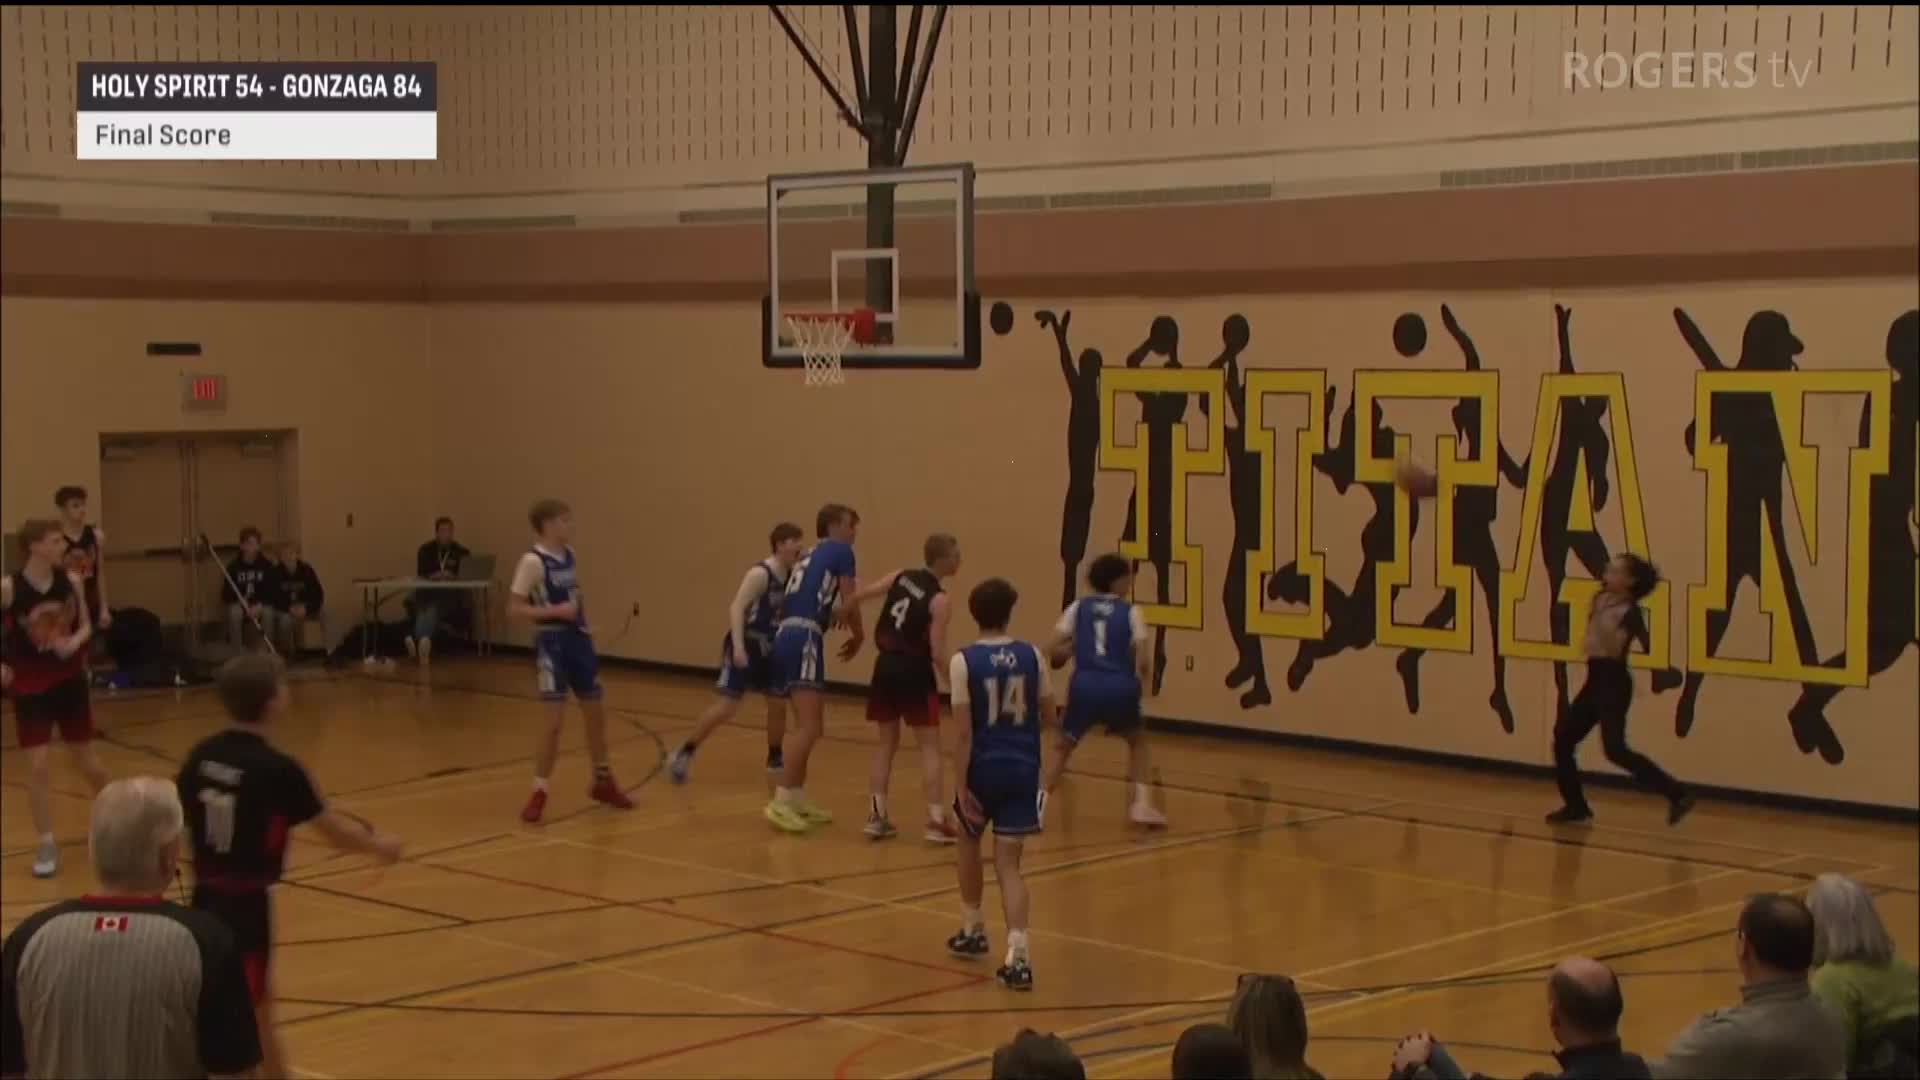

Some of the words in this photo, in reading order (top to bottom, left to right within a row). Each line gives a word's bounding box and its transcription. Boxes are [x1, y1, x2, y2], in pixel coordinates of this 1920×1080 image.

[1099, 367, 1919, 688] TITAN
[890, 596, 911, 630] 4
[1093, 619, 1107, 656] 1
[983, 674, 1028, 728] 14
